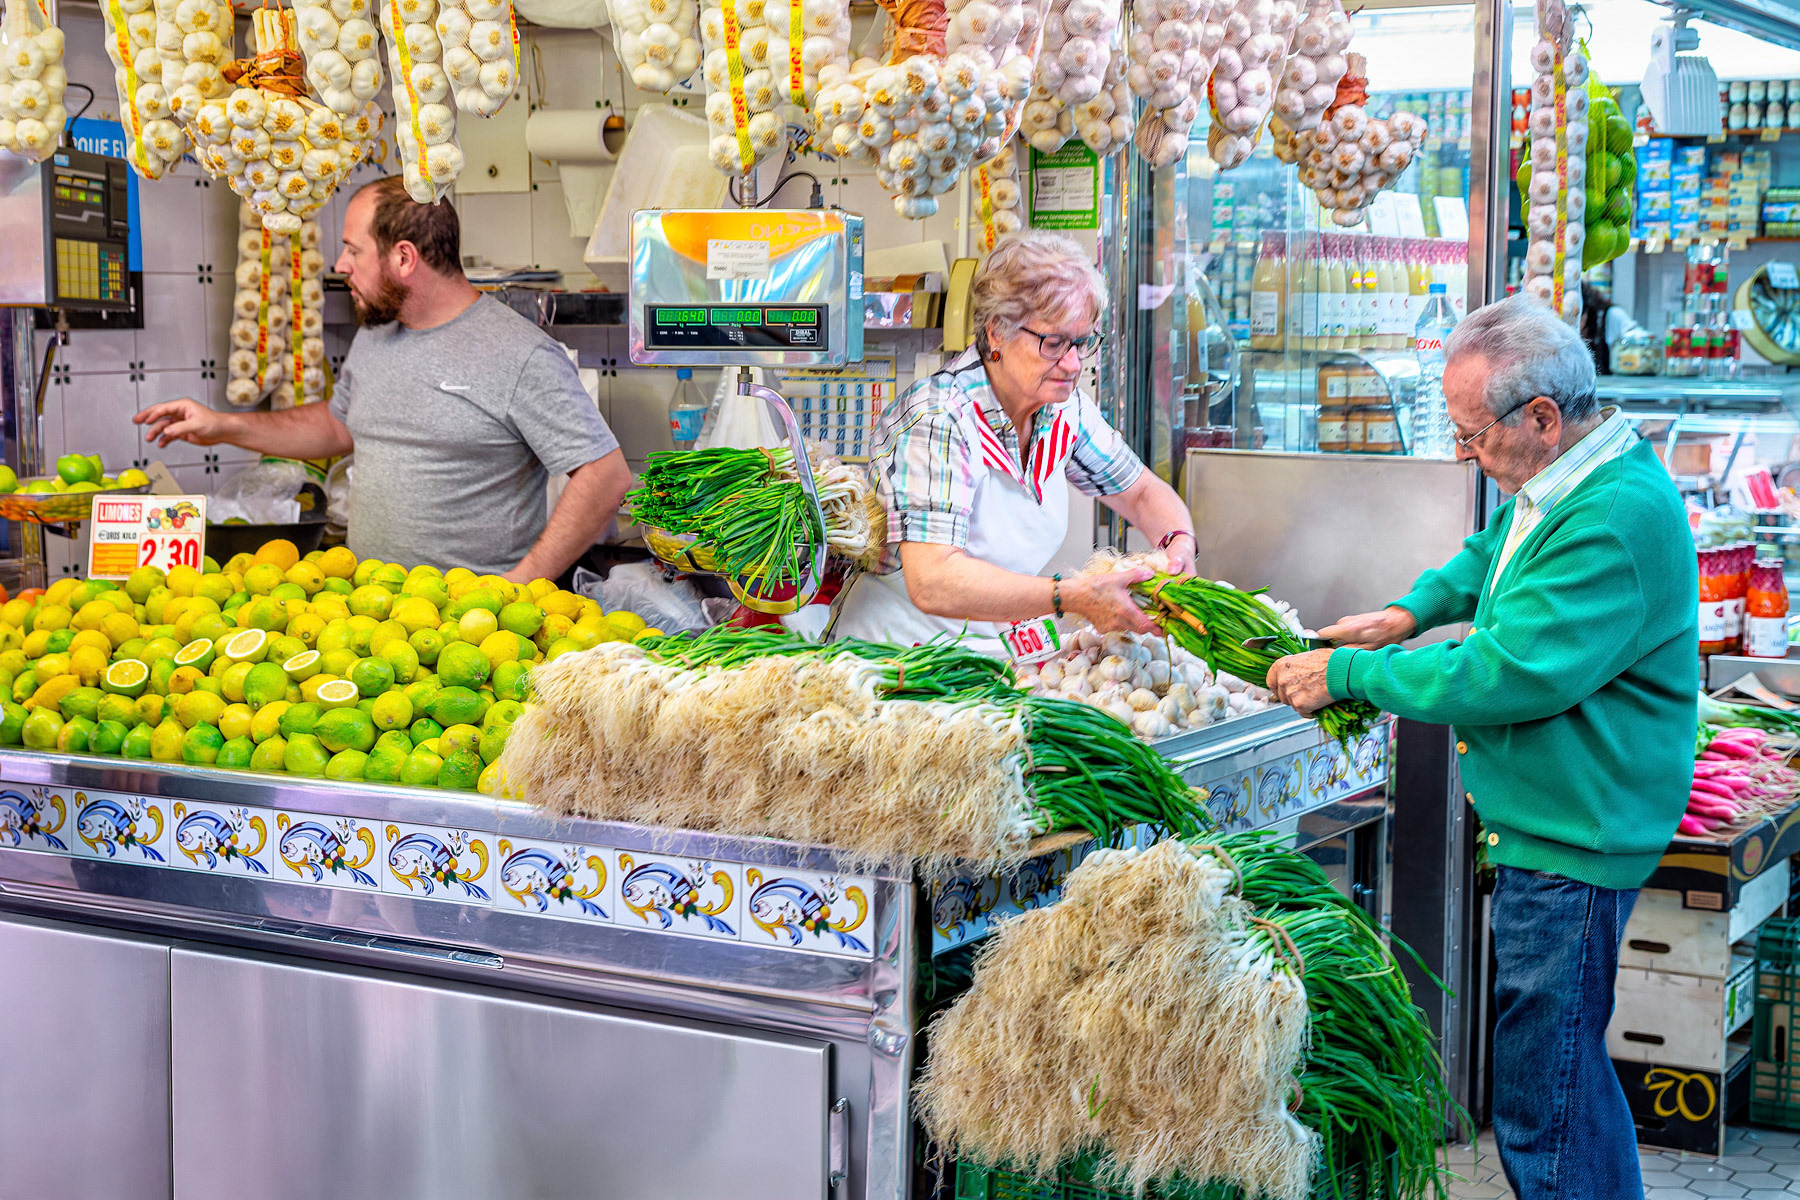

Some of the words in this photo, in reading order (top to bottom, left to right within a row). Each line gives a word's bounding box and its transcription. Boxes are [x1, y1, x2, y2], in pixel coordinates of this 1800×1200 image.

[1415, 338, 1442, 351] OYA
[100, 504, 141, 521] LIMONES
[122, 532, 137, 540] KILO
[1008, 627, 1043, 657] 160
